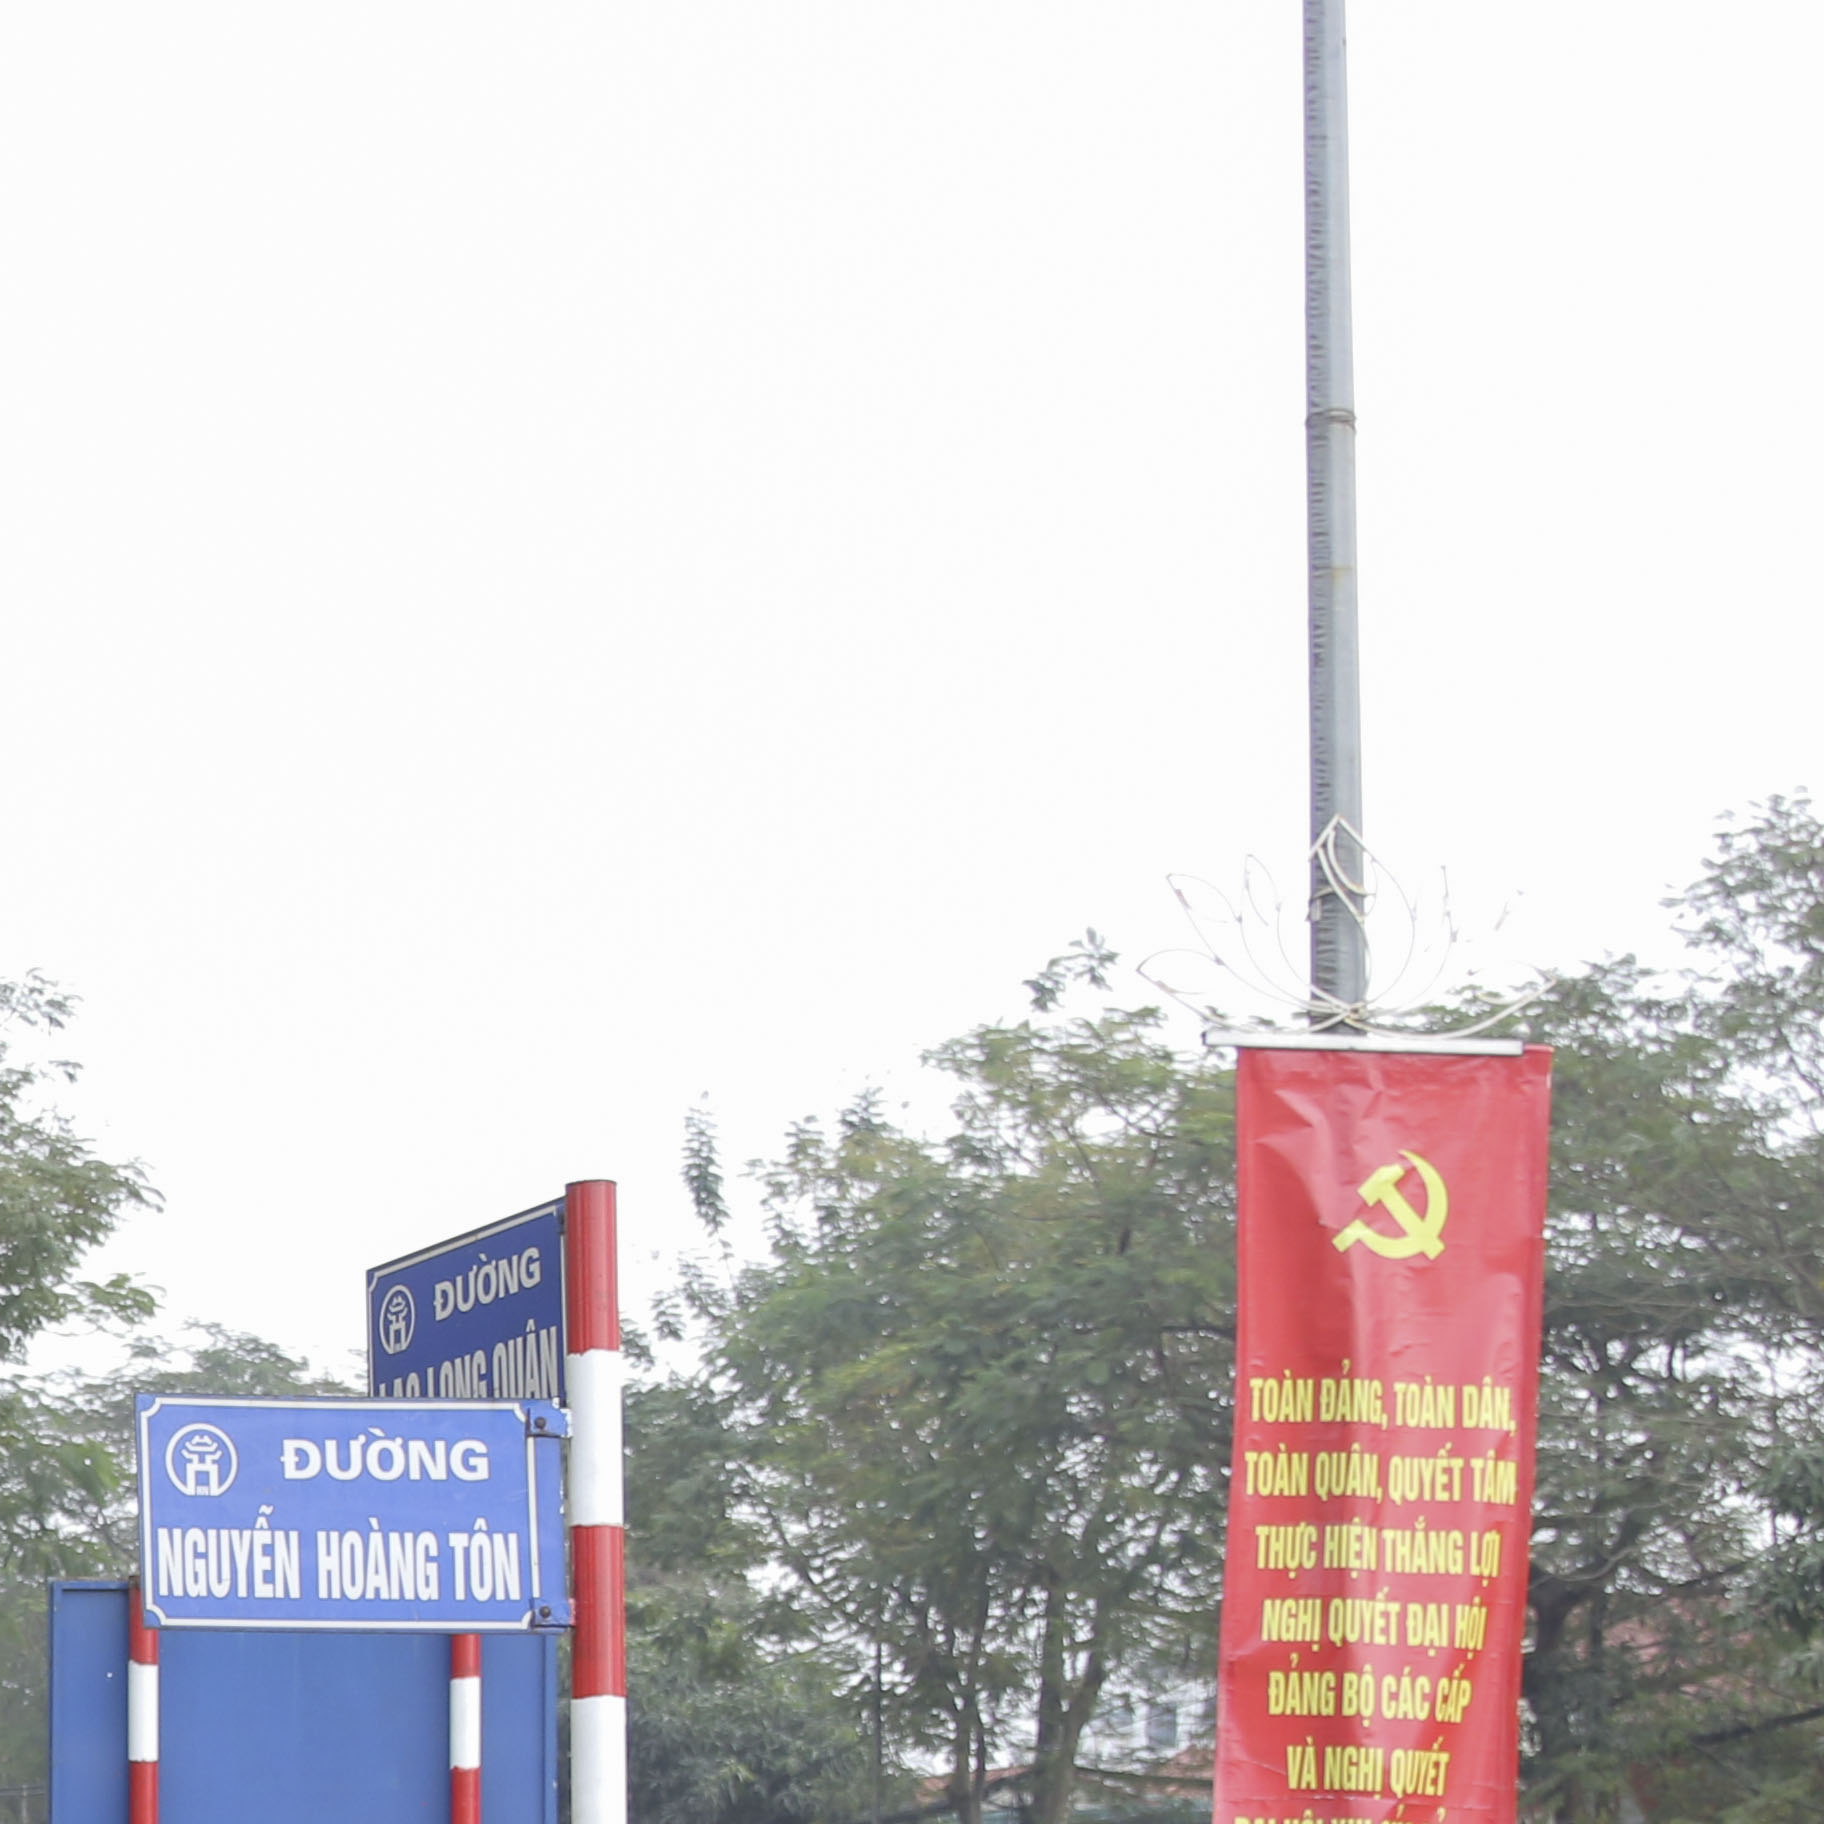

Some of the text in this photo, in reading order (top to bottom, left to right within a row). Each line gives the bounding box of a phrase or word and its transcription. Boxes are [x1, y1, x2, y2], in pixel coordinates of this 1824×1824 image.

[433, 1246, 542, 1321] ĐƯỜNG
[1250, 1358, 1516, 1437] TOÀN ĐẢNG, TOÀN DÂN,
[281, 1428, 489, 1481] ĐƯỜNG
[1244, 1442, 1518, 1506] TOÀN QUÂN, QUYẾT TÂM
[158, 1505, 520, 1601] NGUYỄN HOÀNG TÔN
[1255, 1516, 1501, 1587] THỰC HIỆN THẮNG LỢI
[1261, 1586, 1487, 1660] NGHỊ QUYẾT ĐẠI HỘI
[1267, 1652, 1472, 1727] ĐẢNG BỘ CÁC CẤP
[1286, 1736, 1450, 1800] VÀ NGHỊ QUYẾT
